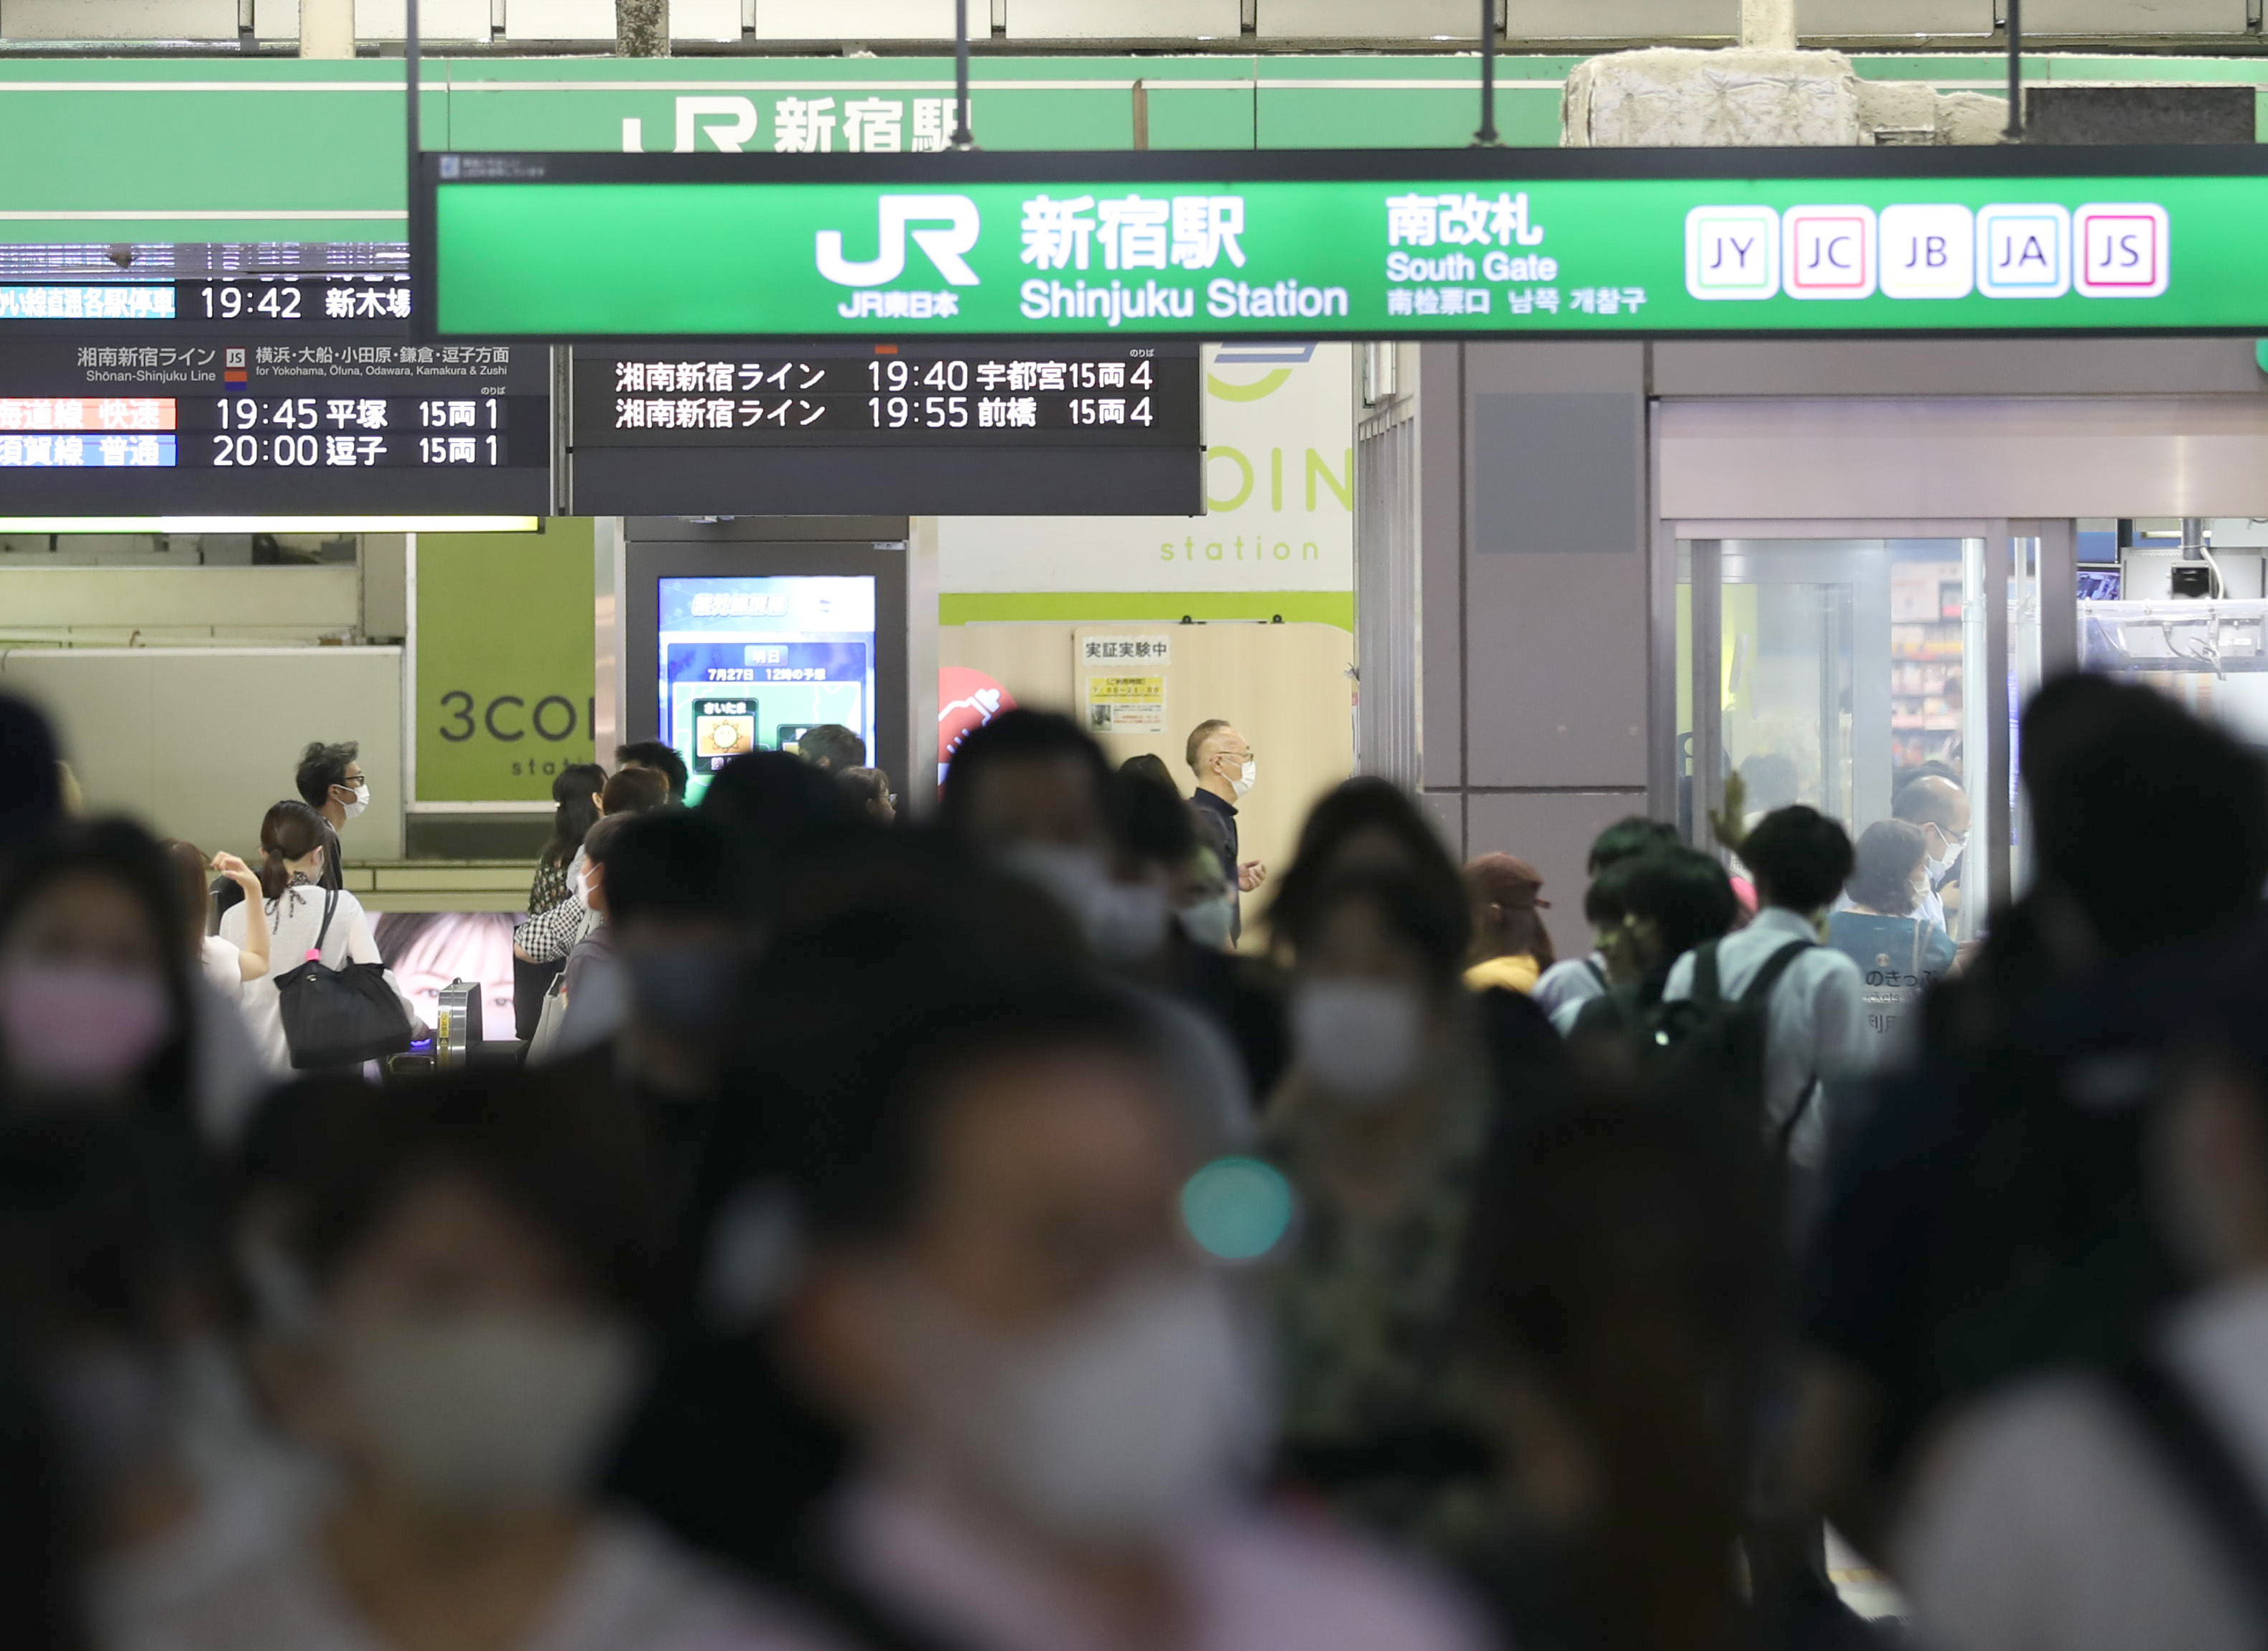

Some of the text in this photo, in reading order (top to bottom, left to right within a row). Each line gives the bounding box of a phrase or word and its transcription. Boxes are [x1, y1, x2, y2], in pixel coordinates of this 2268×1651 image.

[775, 97, 971, 151] 新宿駅
[1020, 194, 1246, 270] 新宿駅
[1386, 192, 1544, 245] 南改札
[816, 195, 980, 286] JR
[1712, 235, 2138, 268] JY JC JB JA JS
[1387, 251, 1557, 281] South Gate
[202, 288, 301, 317] 19:42
[325, 288, 411, 318] 新木場
[838, 291, 958, 318] JR東日本
[1020, 279, 1348, 327] Shinjuku Station
[1508, 287, 1647, 314] 남쪽 개찰구
[78, 347, 216, 368] 湘南新宿ライン
[1129, 348, 1155, 357] のりば
[86, 370, 216, 384] Shōnan-Shinjuku Line
[256, 365, 270, 376] for
[271, 365, 327, 378] Yokohama,
[365, 365, 414, 378] Odawara,
[416, 365, 467, 376] Kamakura
[469, 365, 477, 376] &
[479, 365, 508, 376] Zushi
[616, 362, 824, 391] 湘南新宿ライン
[869, 361, 967, 390] 19:40
[1131, 360, 1152, 390] 4
[480, 386, 506, 396] のりば
[98, 400, 160, 430] 快速
[218, 399, 317, 429] 19:45
[327, 399, 388, 429] 平塚
[420, 401, 475, 426] 15両
[486, 399, 496, 429] 1
[616, 397, 1152, 428] 湘南新宿ライン 19:55 前橋 15両 4
[99, 436, 159, 466] 普通
[214, 436, 317, 465] 20:00
[327, 436, 387, 465] 逗子
[420, 438, 475, 462] 15両
[486, 435, 496, 465] 1
[1160, 535, 1318, 561] station
[752, 649, 780, 663] 明日
[1086, 642, 1167, 658] 実証実験中
[707, 668, 754, 681] 7月27日
[704, 701, 747, 714] さいたま
[1866, 969, 1933, 987] のきっ
